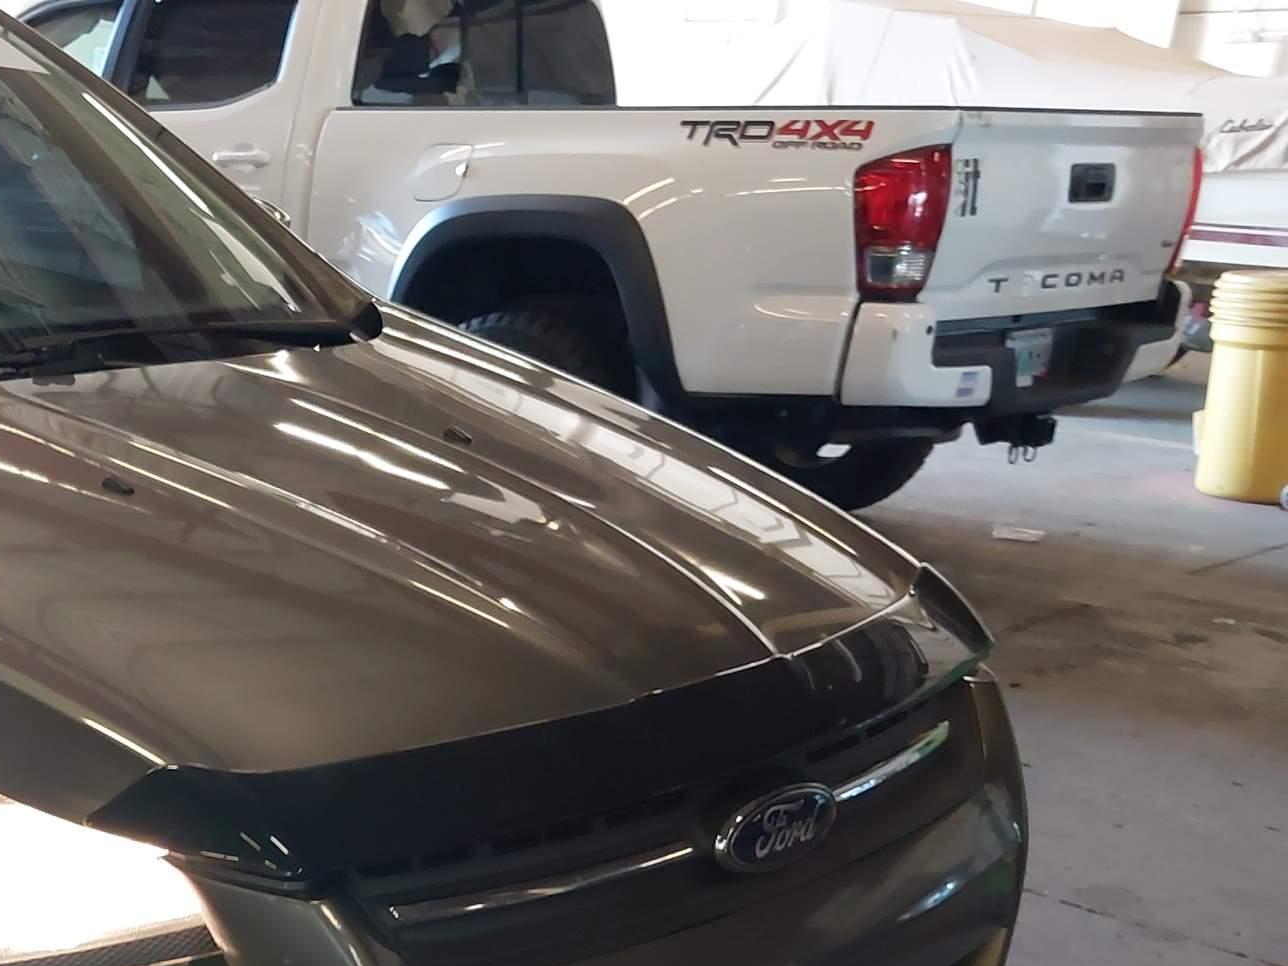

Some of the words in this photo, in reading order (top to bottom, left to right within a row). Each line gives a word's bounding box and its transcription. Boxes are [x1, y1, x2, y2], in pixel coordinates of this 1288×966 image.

[680, 120, 775, 148] TRD
[772, 140, 809, 150] OFF
[811, 140, 863, 151] ROAD
[755, 799, 818, 859] Ford
